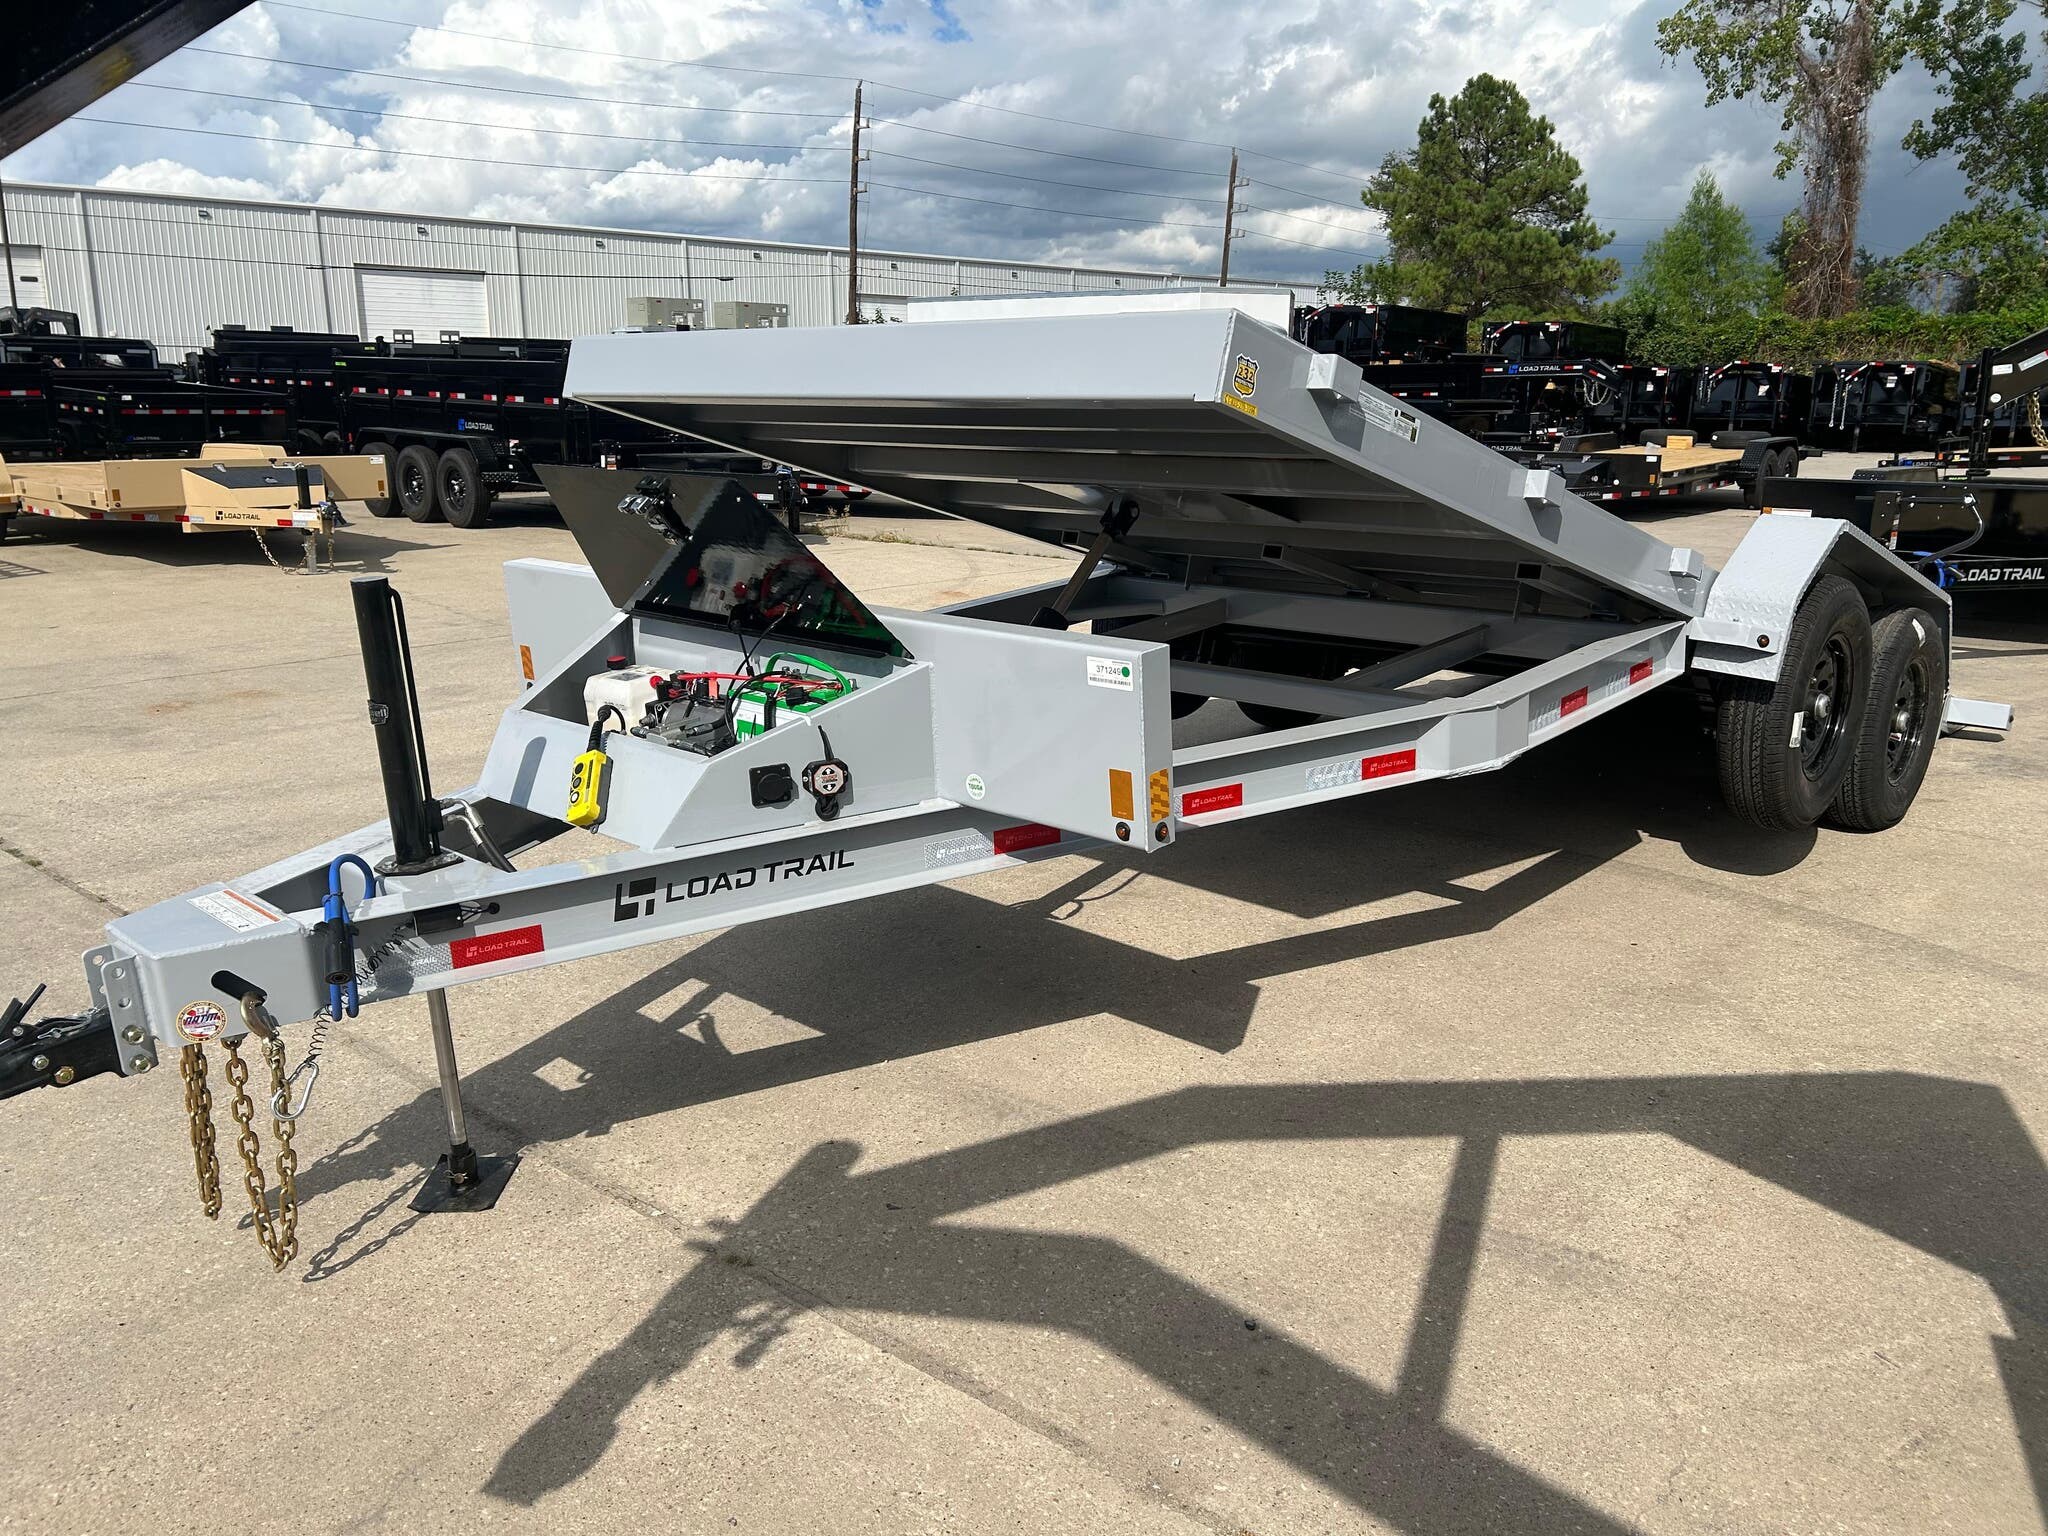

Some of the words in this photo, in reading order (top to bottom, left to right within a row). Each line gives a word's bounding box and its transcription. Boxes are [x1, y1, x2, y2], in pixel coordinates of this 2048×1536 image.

[1239, 366, 1254, 381] 232
[465, 421, 479, 430] LOAD
[479, 422, 494, 431] TRAIL
[2003, 567, 2045, 580] TRAIL
[1096, 665, 1120, 676] 371249
[1378, 761, 1392, 769] LOAD
[1393, 759, 1408, 767] TRAIL
[1200, 797, 1216, 805] LOAD
[1217, 793, 1234, 801] TRAIL
[666, 867, 757, 903] LOAD
[763, 849, 855, 883] TRAIL
[479, 943, 503, 953] LOAD
[504, 938, 530, 949] TRAIL
